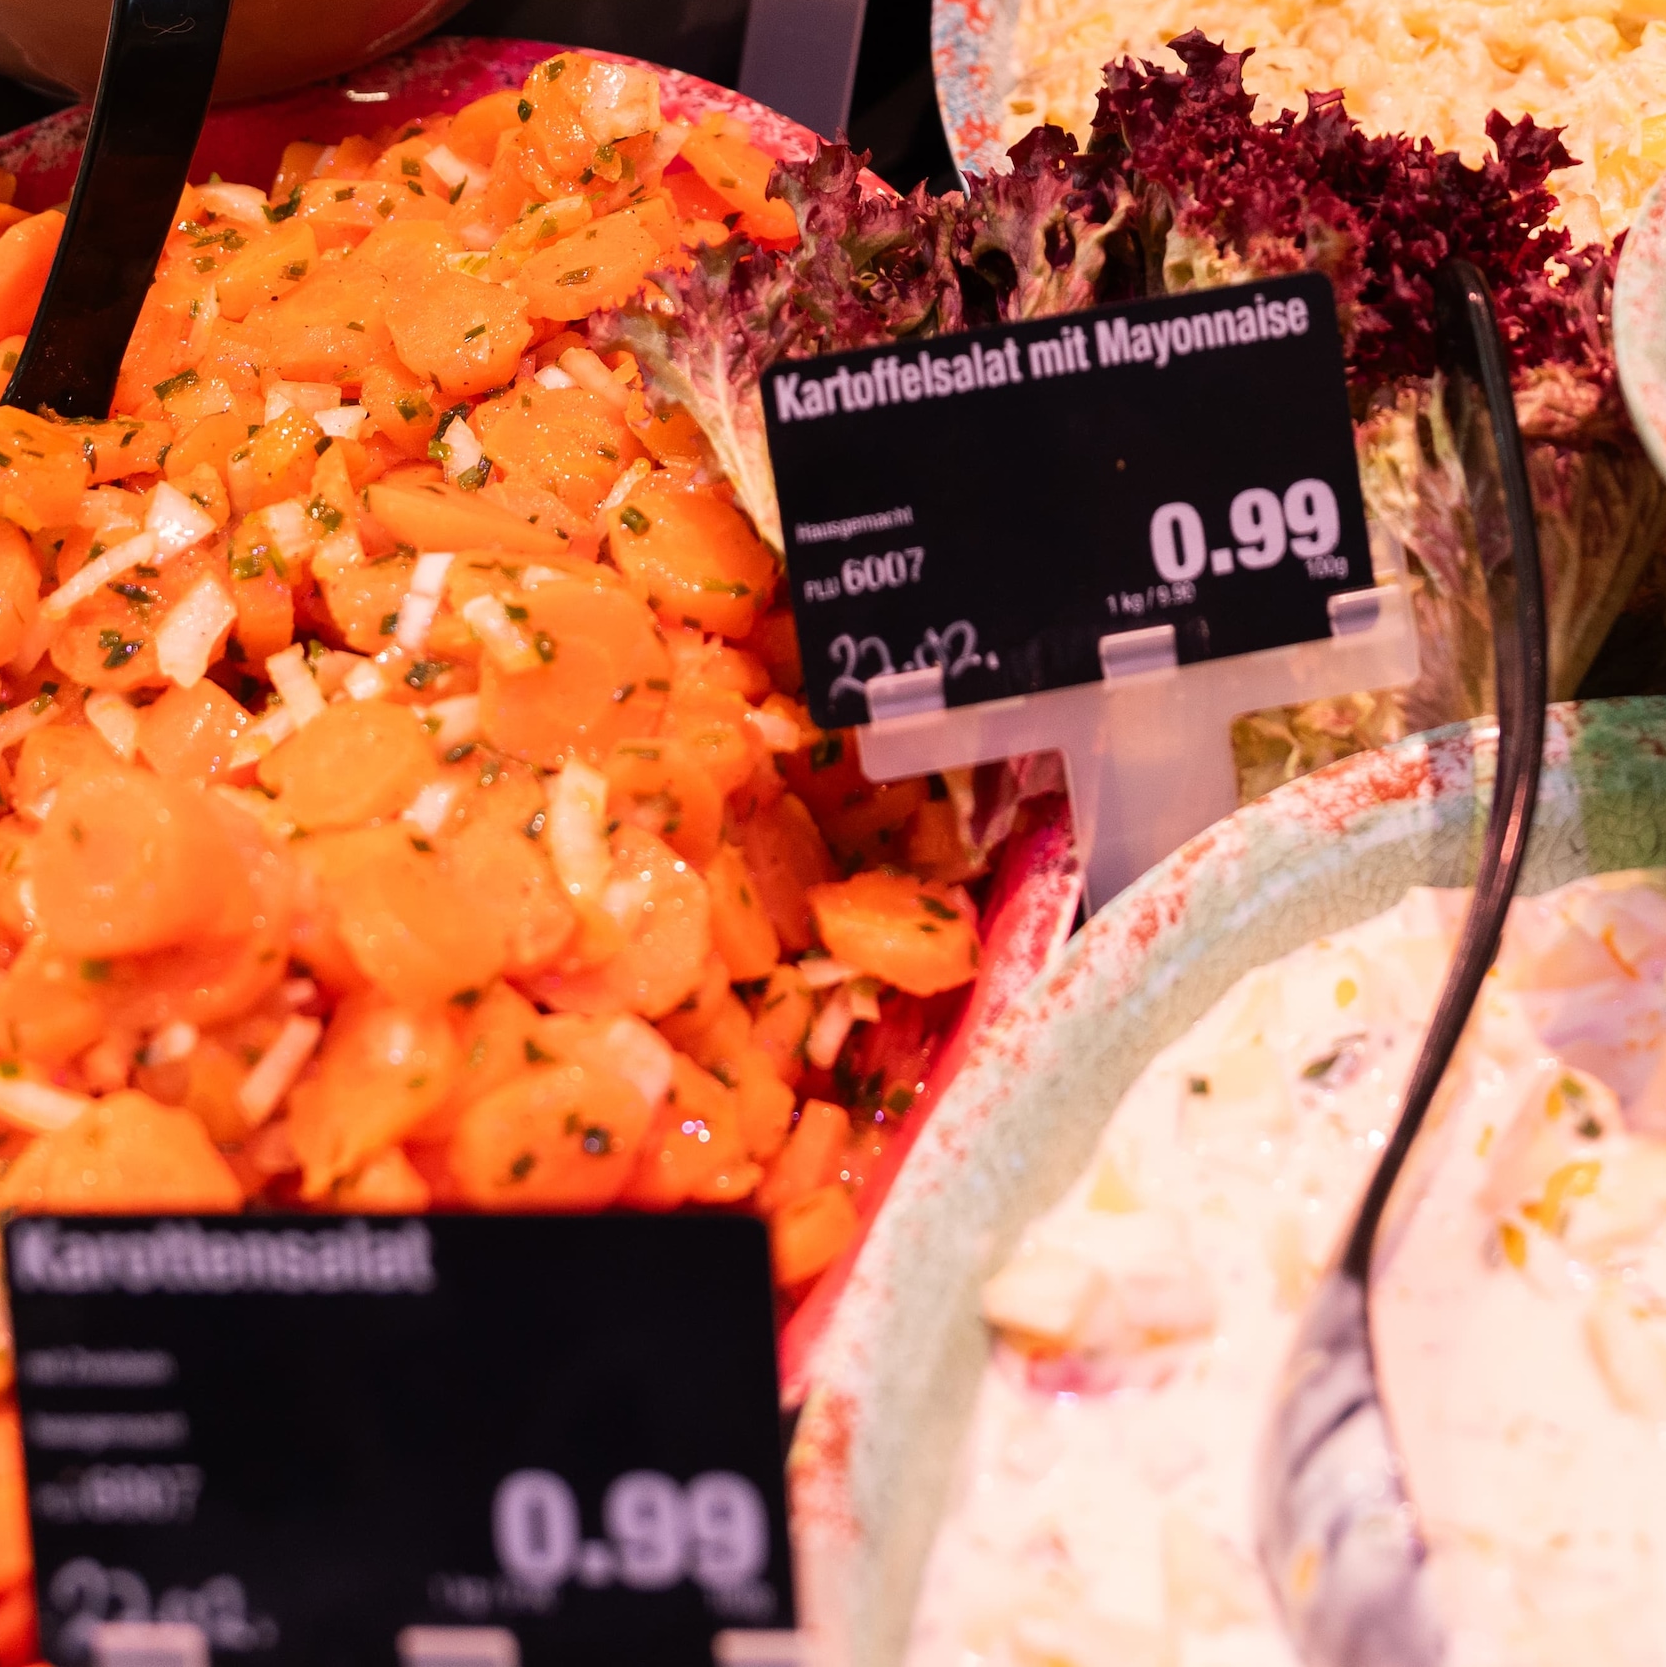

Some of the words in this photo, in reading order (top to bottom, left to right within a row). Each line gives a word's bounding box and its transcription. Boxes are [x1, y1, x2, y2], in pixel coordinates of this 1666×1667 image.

[773, 337, 1023, 423] Kartoffelsalat
[1030, 326, 1091, 380] mit
[1095, 293, 1310, 370] Mayonnaise
[841, 545, 926, 596] 6007
[1149, 478, 1341, 583] 0.99
[493, 1469, 771, 1591] 0.99
